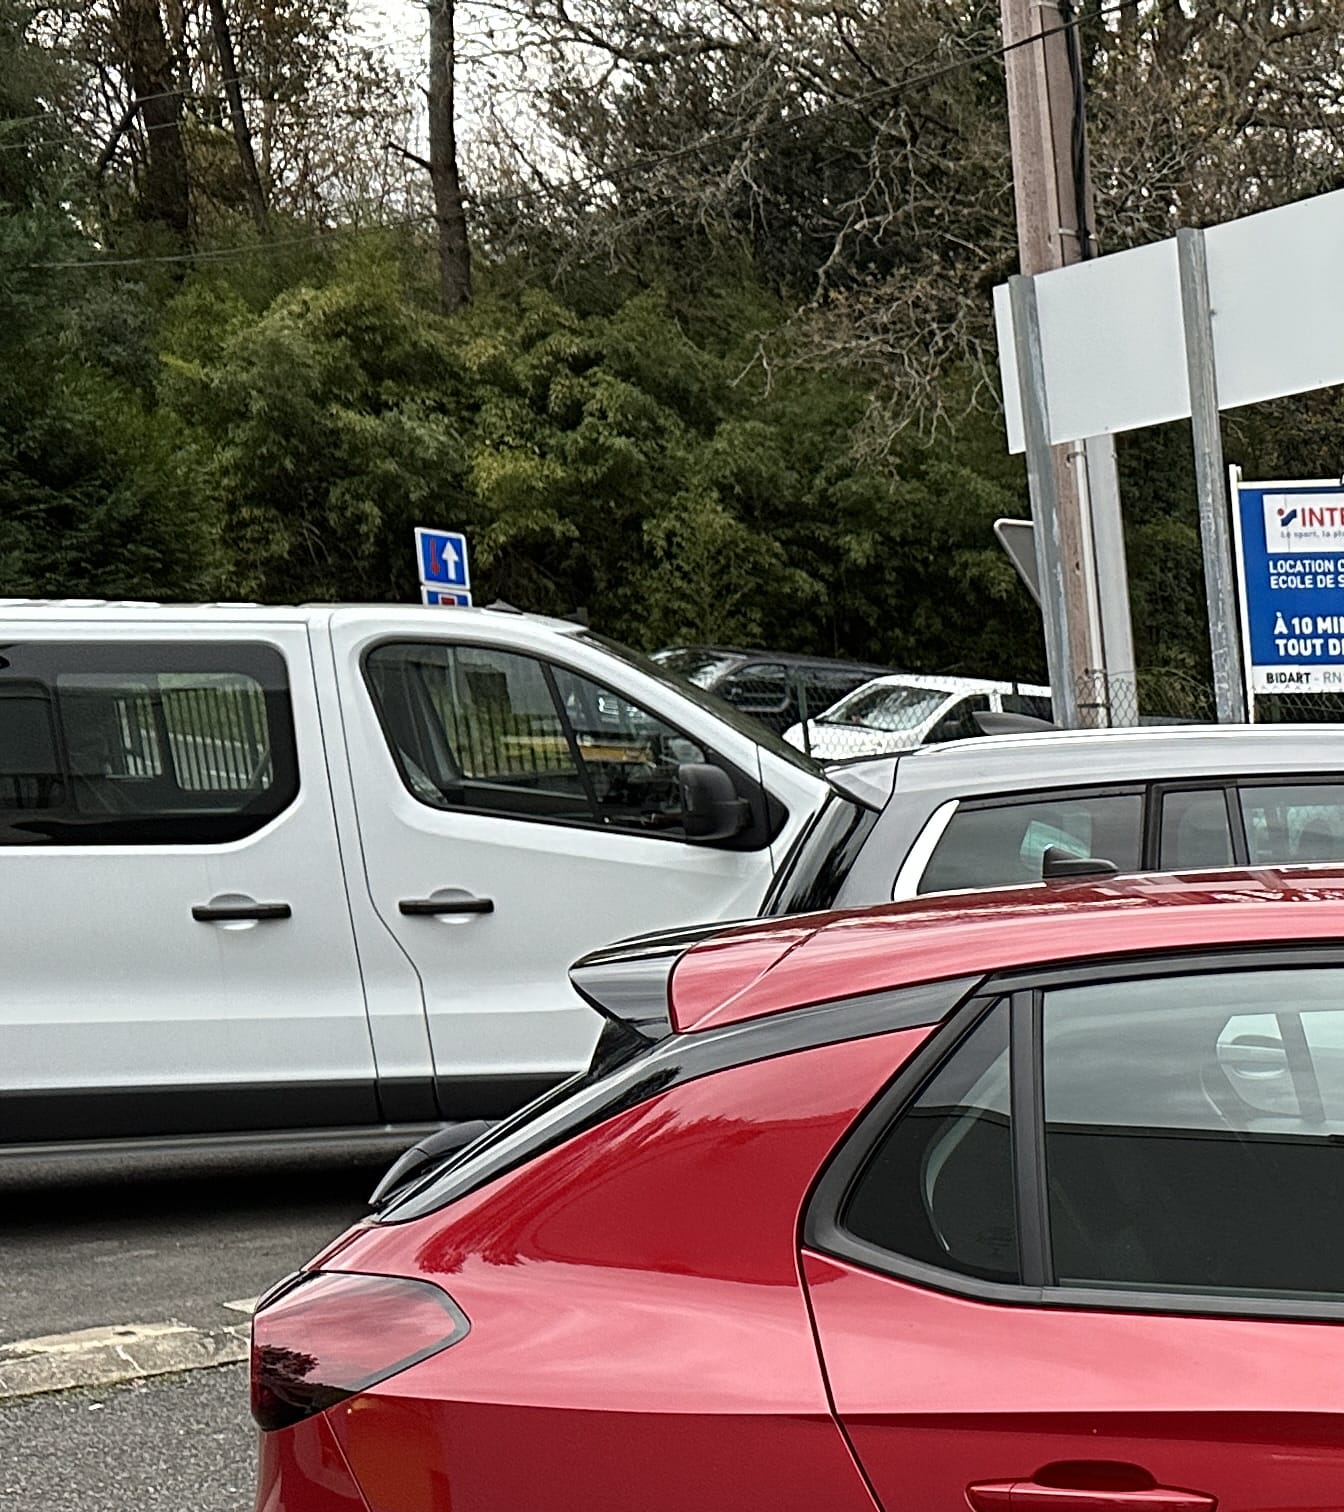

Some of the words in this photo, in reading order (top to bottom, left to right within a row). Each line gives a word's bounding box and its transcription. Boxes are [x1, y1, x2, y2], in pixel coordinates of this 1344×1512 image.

[1269, 559, 1334, 574] LOCATION
[1270, 575, 1313, 589] ECOLE
[1316, 575, 1336, 588] DE
[1274, 611, 1288, 635] À
[1291, 616, 1313, 635] 10
[1275, 638, 1324, 656] TOUT
[1266, 672, 1311, 684] BIDART
